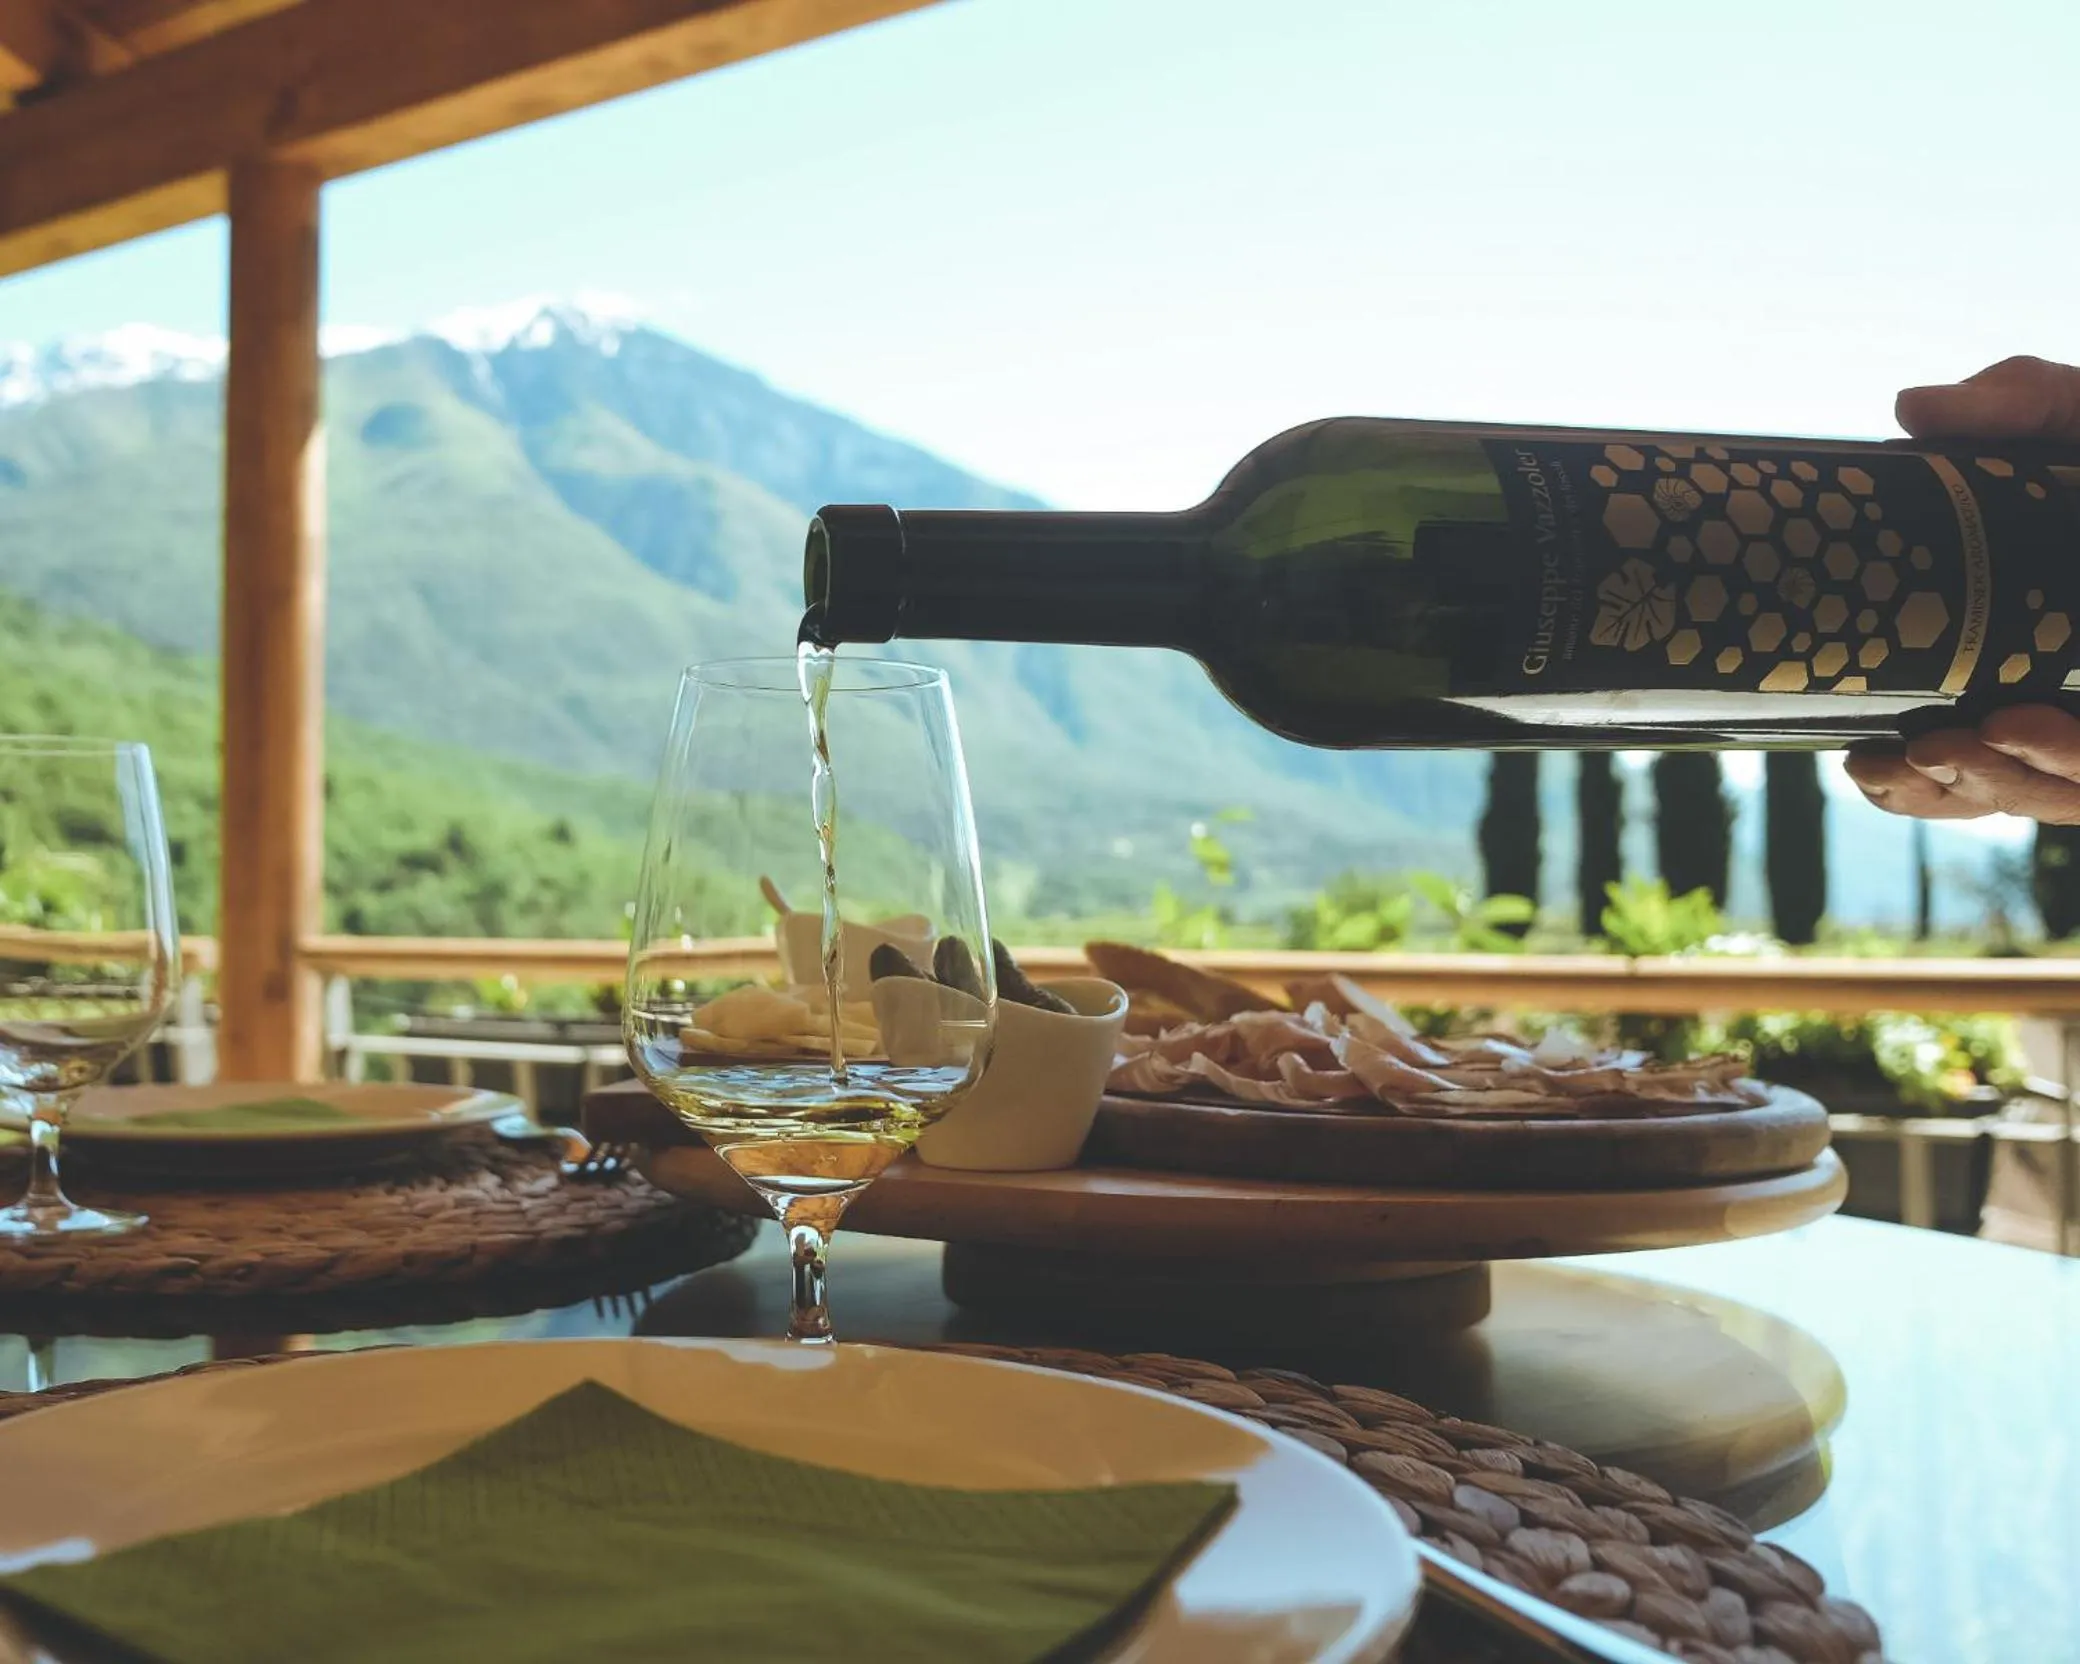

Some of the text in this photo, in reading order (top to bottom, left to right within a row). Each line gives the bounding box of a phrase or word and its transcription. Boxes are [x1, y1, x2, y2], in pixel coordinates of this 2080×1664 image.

[1515, 448, 1557, 544] Vazzoler
[1522, 552, 1568, 675] Giuseppe
[1964, 573, 1985, 653] TRAMINER
